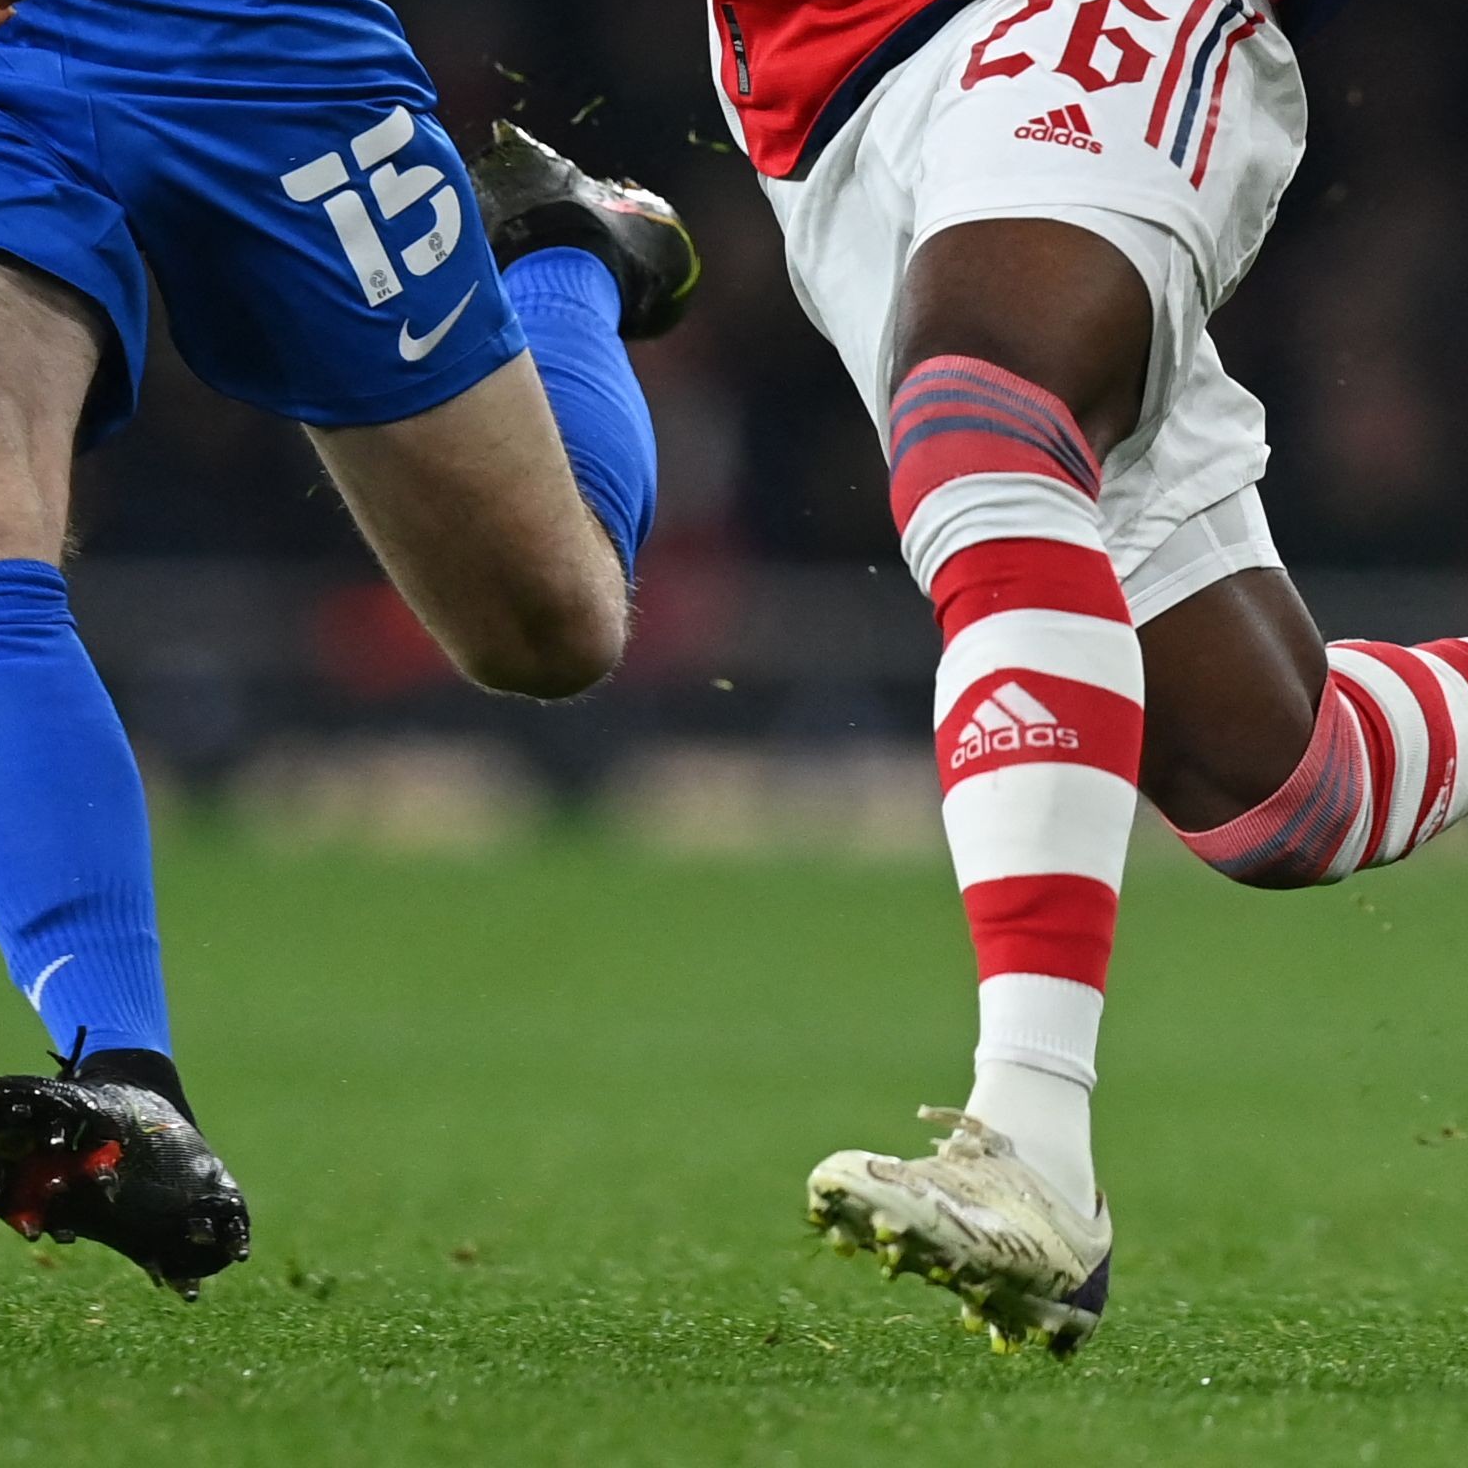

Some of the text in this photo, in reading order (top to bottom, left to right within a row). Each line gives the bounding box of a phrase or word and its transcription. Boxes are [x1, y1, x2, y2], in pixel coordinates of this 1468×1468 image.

[1013, 122, 1103, 156] adidas
[280, 105, 462, 309] 15
[435, 250, 447, 262] EFL
[377, 287, 392, 299] EFL
[950, 722, 1080, 770] adidas
